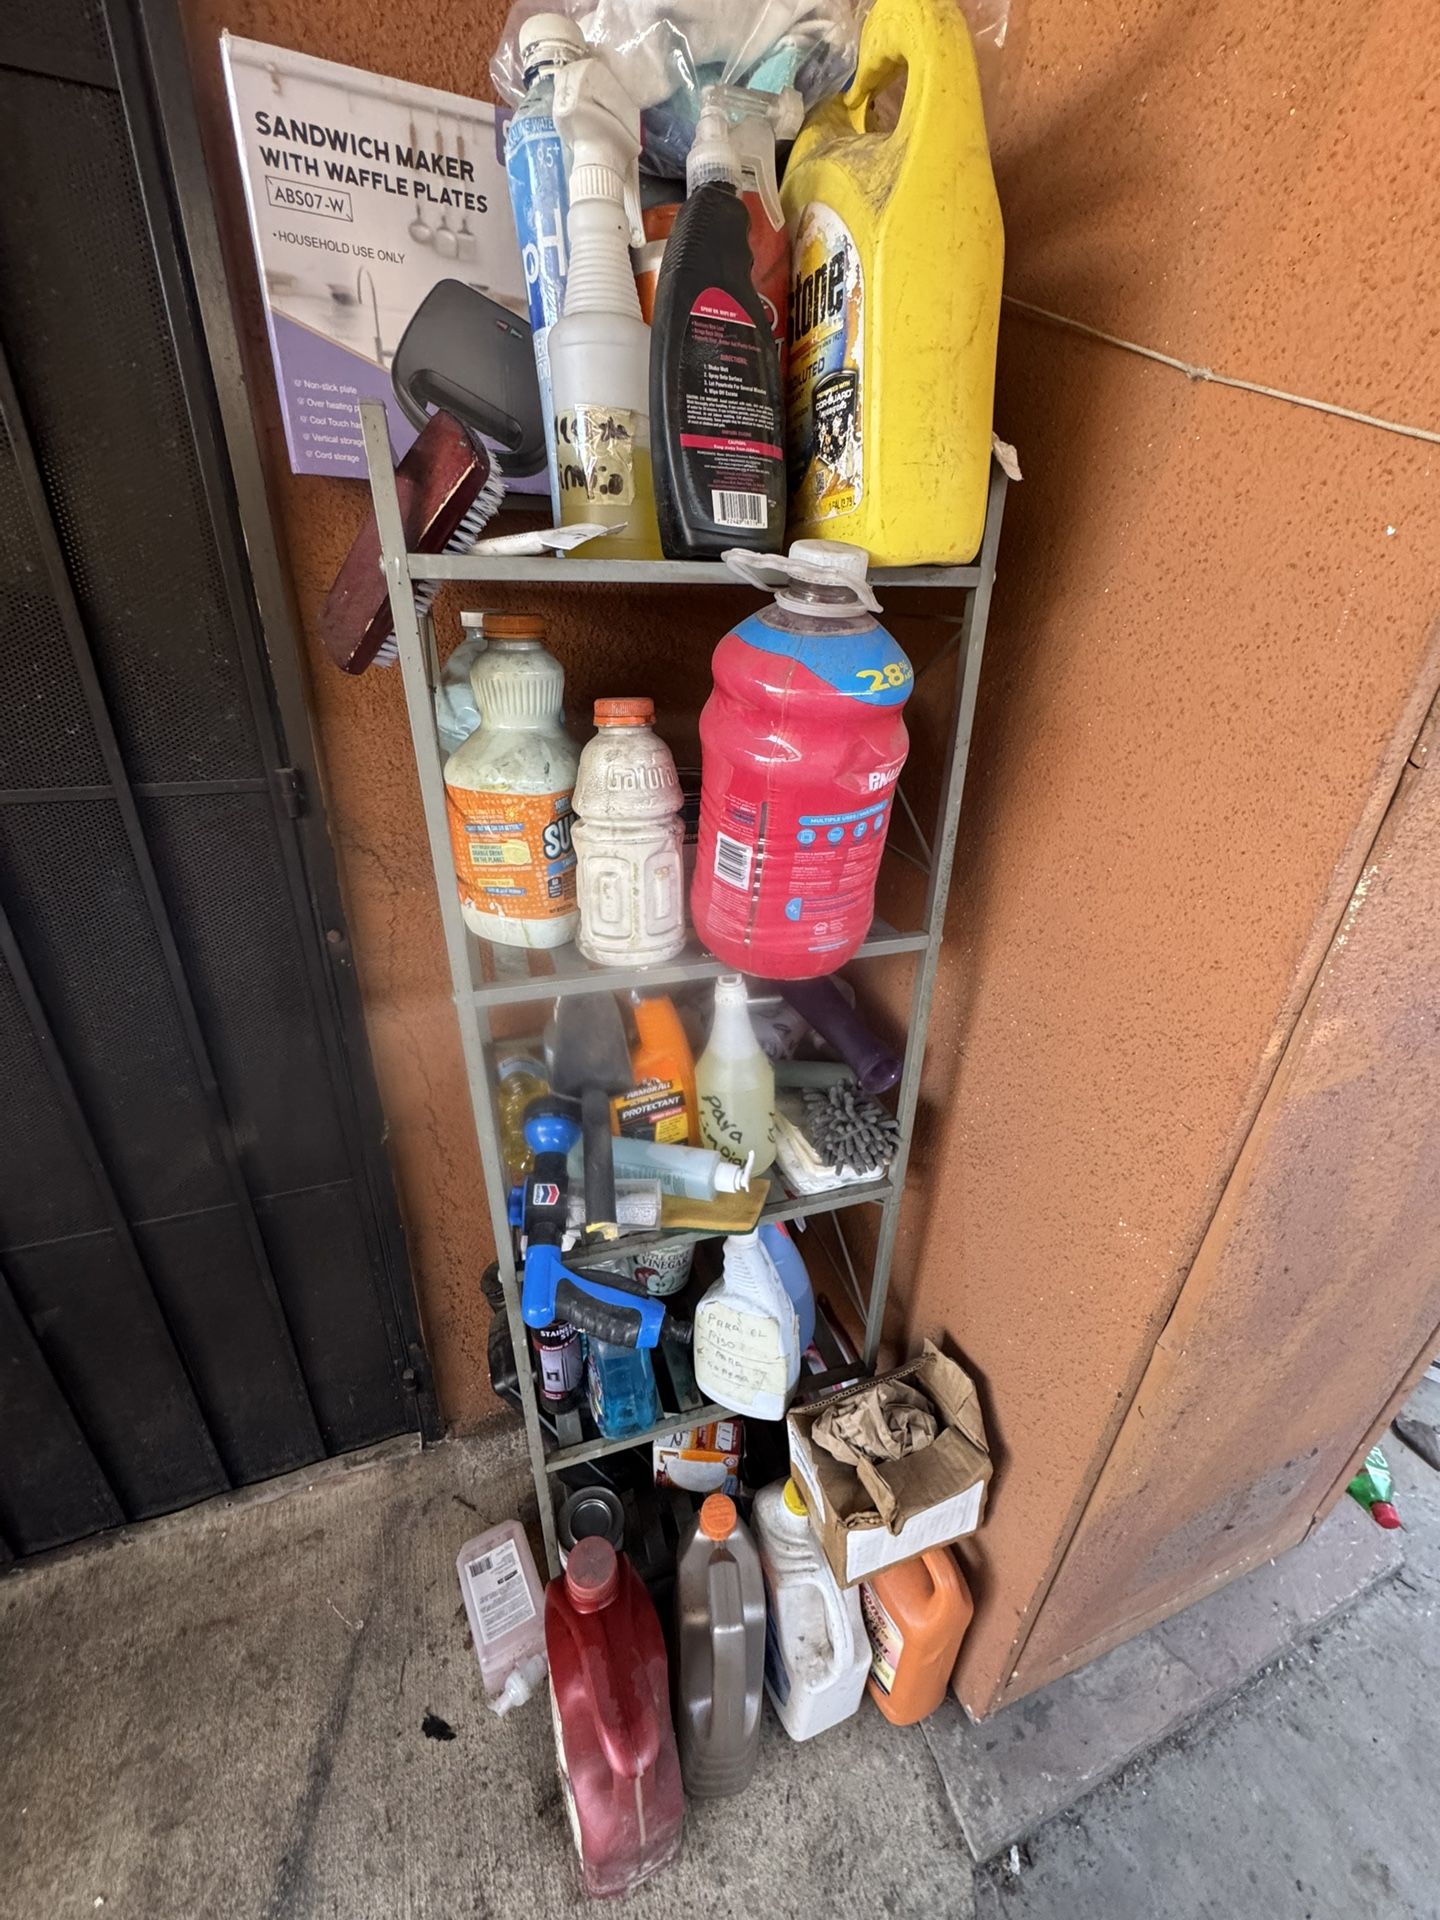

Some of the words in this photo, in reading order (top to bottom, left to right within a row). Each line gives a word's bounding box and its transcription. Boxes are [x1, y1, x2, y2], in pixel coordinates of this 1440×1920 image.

[255, 111, 389, 162] SANDWICH
[396, 145, 474, 182] MAKER
[259, 146, 319, 177] WITH
[324, 161, 408, 196] WAFFLE
[413, 180, 488, 213] PLATES
[275, 186, 344, 213] ABS07-W
[279, 231, 349, 254] HOUSEHOLD
[352, 245, 374, 259] USE
[378, 250, 405, 264] ONLY
[309, 416, 326, 425] Cool
[622, 1096, 680, 1119] PROTECTANT
[642, 1254, 688, 1270] VINEGAR
